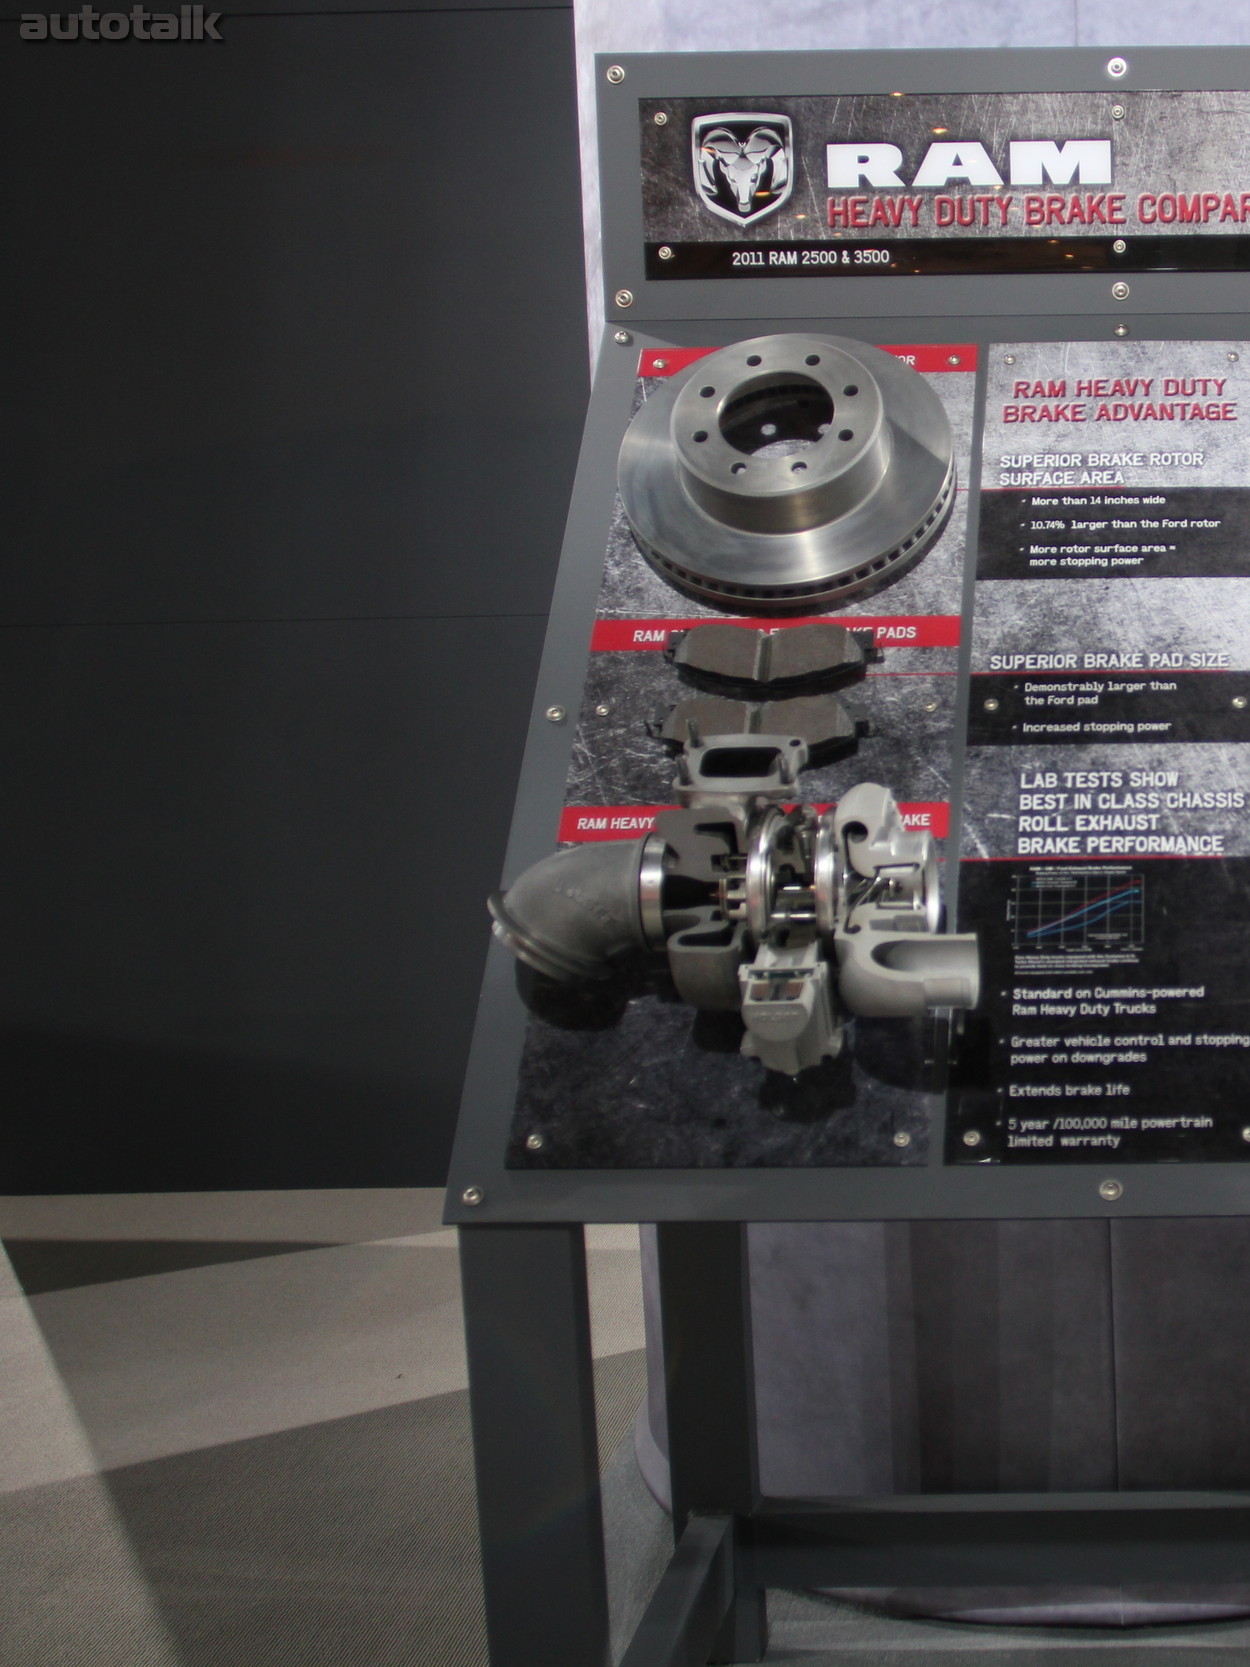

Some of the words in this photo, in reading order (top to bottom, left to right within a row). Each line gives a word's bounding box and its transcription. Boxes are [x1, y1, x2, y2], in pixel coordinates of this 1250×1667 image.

[826, 140, 1112, 188] RAM
[827, 194, 923, 229] HEAVY
[934, 193, 1014, 227] DUTY
[1024, 192, 1127, 225] BRAKE
[732, 251, 765, 266] 2011
[769, 251, 798, 265] RAM
[801, 250, 837, 264] 2500
[841, 250, 850, 264] &
[854, 250, 890, 263] 3500
[1012, 380, 1066, 399] RAM
[1075, 378, 1153, 398] HEAVY
[1163, 377, 1227, 397] DUTY
[1002, 403, 1087, 424] BRAKE
[1095, 402, 1238, 423] ADVANTAGE
[1000, 453, 1082, 468] SUPERIOR
[1088, 453, 1144, 467] BRAKE
[1149, 452, 1205, 467] ROTOR
[1000, 471, 1075, 486] SURFACE
[1079, 470, 1125, 485] AREA
[1031, 496, 1059, 506] More
[1062, 496, 1087, 505] than
[1090, 496, 1102, 505] 14
[1104, 495, 1140, 505] inches
[1142, 495, 1166, 505] wide
[1030, 520, 1066, 530] 10.74%
[1071, 520, 1109, 531] larger
[1111, 519, 1137, 529] than
[1140, 519, 1160, 528] the
[1162, 519, 1188, 528] Ford
[1190, 519, 1221, 528] rotor
[1030, 545, 1057, 554] More
[1060, 545, 1091, 554] rotor
[1094, 544, 1138, 553] surface
[1141, 545, 1167, 553] area
[1029, 557, 1057, 566] more
[1059, 556, 1108, 567] stopping
[1111, 557, 1144, 566] power
[633, 630, 665, 642] RAM
[877, 626, 917, 639] PADS
[990, 655, 1077, 671] SUPERIOR
[1084, 653, 1144, 669] BRAKE
[1149, 653, 1183, 668] PAD
[1189, 652, 1230, 668] SIZE
[1024, 681, 1104, 693] Demonstrably
[1108, 681, 1146, 693] larger
[1150, 681, 1177, 691] than
[1024, 696, 1044, 705] the
[1047, 695, 1075, 705] Ford
[1077, 695, 1099, 706] pad
[1022, 722, 1081, 732] Increased
[1083, 721, 1135, 733] stopping
[1137, 722, 1172, 733] power
[1020, 772, 1058, 789] LAB
[1063, 772, 1123, 788] TESTS
[1129, 771, 1180, 788] SHOW
[1019, 794, 1068, 810] BEST
[1074, 794, 1092, 809] IN
[1098, 793, 1160, 809] CLASS
[1166, 792, 1245, 808] CHASSIS
[577, 817, 607, 830] RAM
[610, 816, 655, 830] HEAVY
[1018, 815, 1069, 832] ROLL
[1075, 814, 1160, 831] EXHAUST
[1017, 836, 1081, 854] BRAKE
[1086, 835, 1225, 853] PERFORMANCE
[1012, 987, 1073, 1000] Standard
[1075, 989, 1092, 999] on
[1094, 986, 1205, 1000] Cummins-powered
[1012, 1004, 1037, 1015] Ram
[1040, 1003, 1077, 1017] Heavy
[1079, 1003, 1110, 1017] Duty
[1113, 1002, 1157, 1014] Trucks
[1010, 1036, 1061, 1048] Greater
[1064, 1035, 1111, 1047] vehicle
[1114, 1033, 1165, 1046] control
[1168, 1033, 1192, 1045] and
[1194, 1033, 1250, 1048] stopping
[1010, 1053, 1048, 1066] power
[1051, 1053, 1068, 1063] on
[1071, 1051, 1147, 1066] downgrades
[1008, 1084, 1062, 1097] Extends
[1065, 1084, 1102, 1096] brake
[1105, 1083, 1131, 1096] life
[1008, 1118, 1018, 1130] 5
[1020, 1119, 1049, 1132] year
[1110, 1117, 1137, 1129] mile
[1007, 1135, 1054, 1148] limited
[1060, 1135, 1121, 1149] warranty
